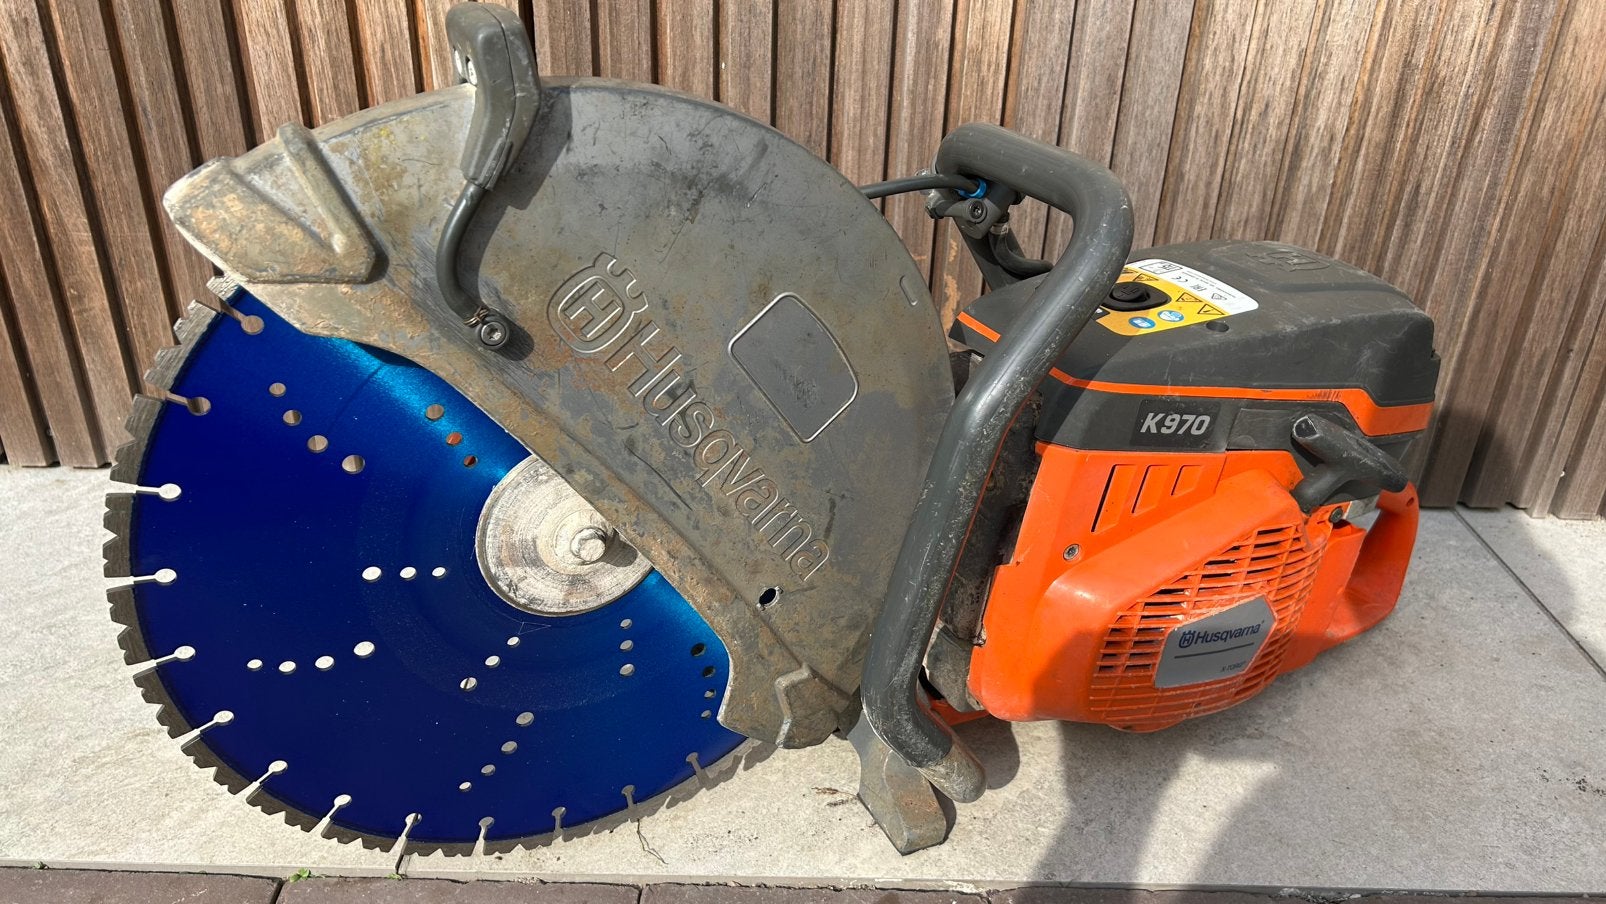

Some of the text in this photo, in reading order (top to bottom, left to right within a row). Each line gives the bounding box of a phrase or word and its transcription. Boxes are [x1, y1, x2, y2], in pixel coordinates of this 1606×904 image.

[1140, 412, 1211, 435] K970
[604, 320, 830, 582] Husqvarna
[1194, 623, 1262, 645] Husqvarna
